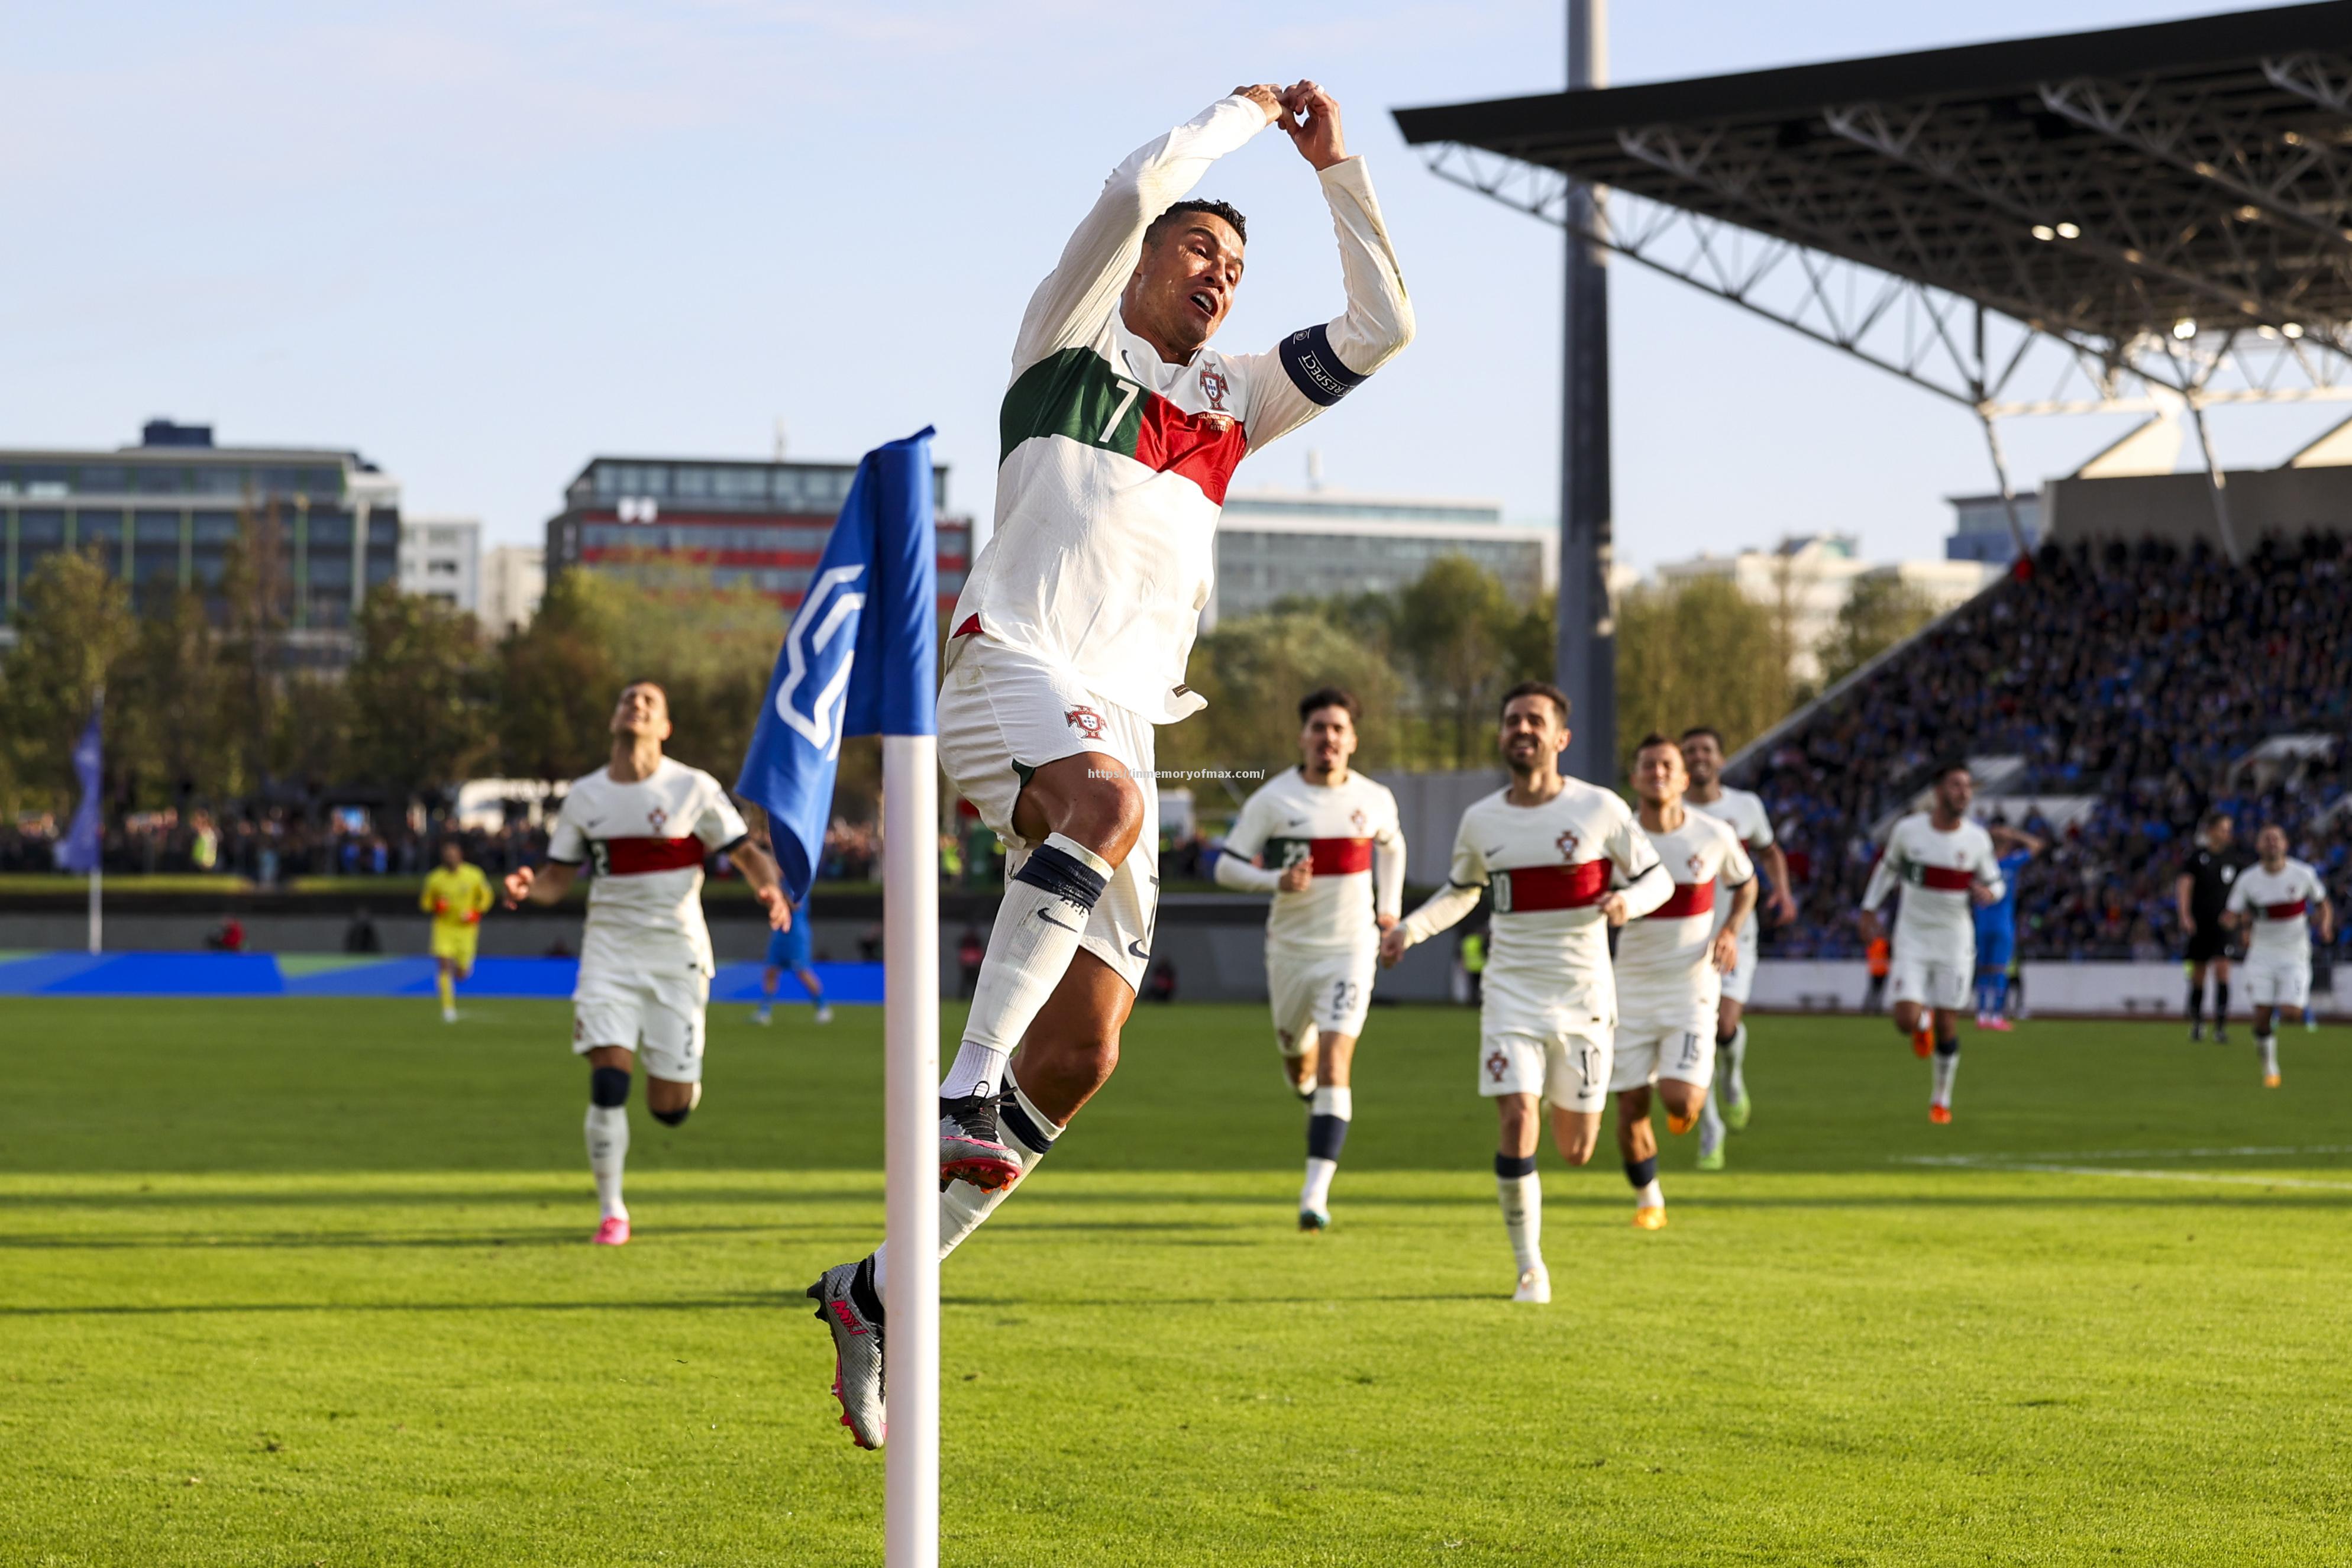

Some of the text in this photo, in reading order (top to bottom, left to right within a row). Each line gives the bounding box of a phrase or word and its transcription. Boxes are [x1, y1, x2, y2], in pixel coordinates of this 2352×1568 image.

[1301, 355, 1345, 393] RESPECT
[1099, 379, 1140, 443] 7
[1683, 1032, 1700, 1062] 15
[1581, 1048, 1601, 1087] 10
